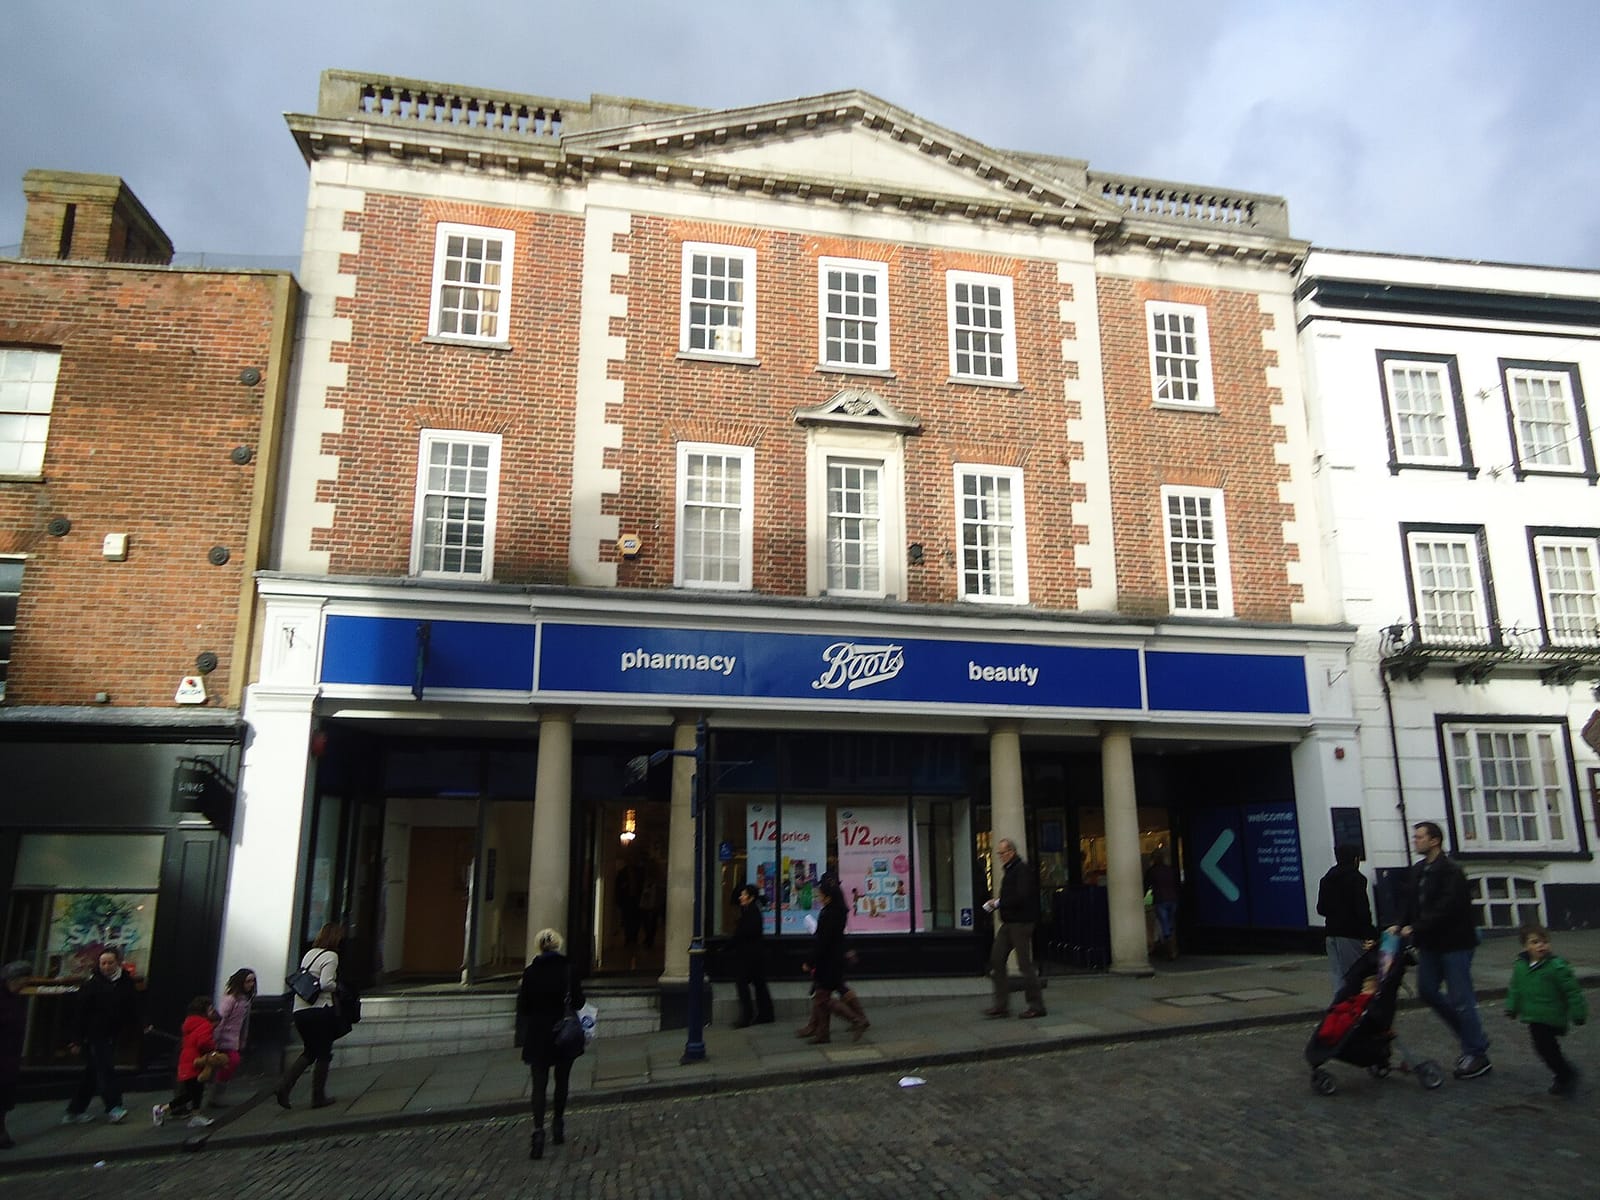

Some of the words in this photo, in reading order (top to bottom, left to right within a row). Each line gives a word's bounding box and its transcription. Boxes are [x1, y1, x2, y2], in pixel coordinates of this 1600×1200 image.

[621, 648, 736, 676] pharmacy
[811, 642, 905, 691] Boots
[968, 660, 1039, 687] beauty
[1247, 811, 1295, 823] welcome
[781, 831, 810, 843] price
[840, 826, 871, 846] 1/2
[872, 834, 902, 847] price
